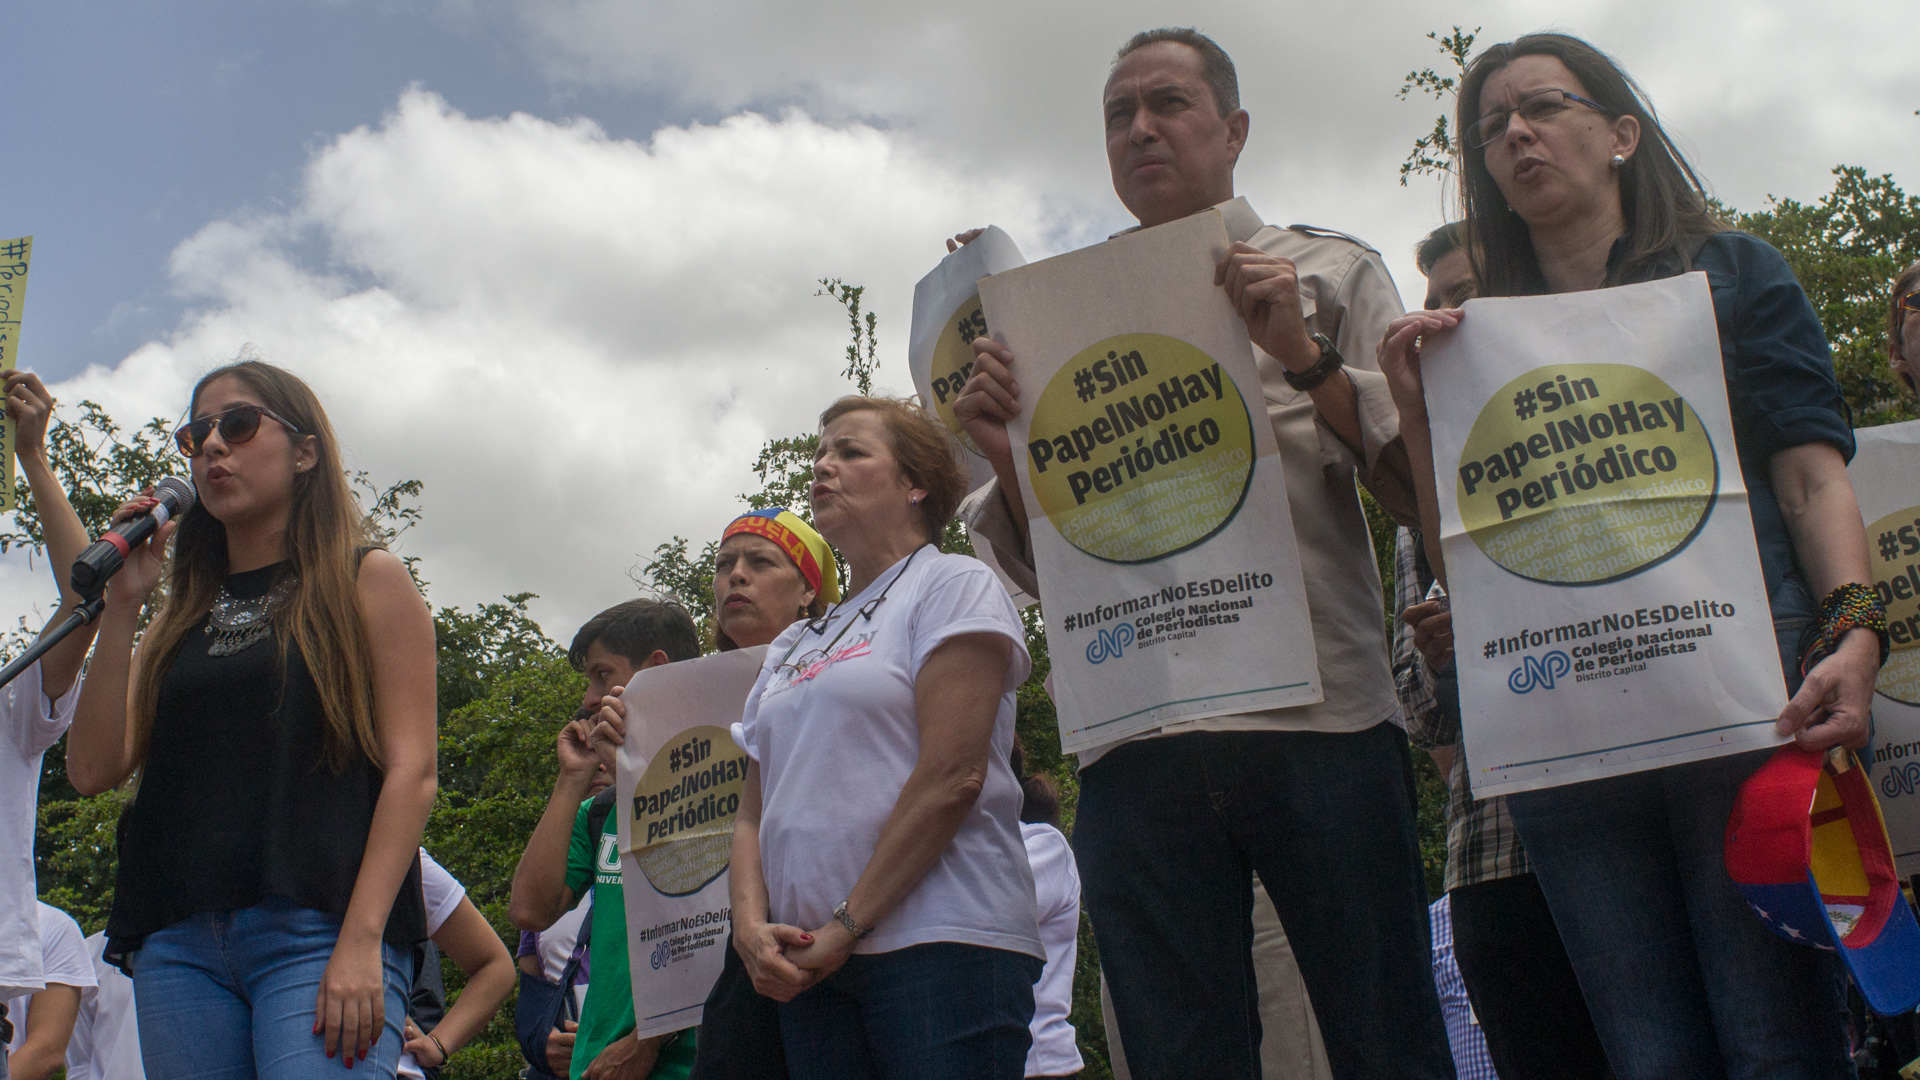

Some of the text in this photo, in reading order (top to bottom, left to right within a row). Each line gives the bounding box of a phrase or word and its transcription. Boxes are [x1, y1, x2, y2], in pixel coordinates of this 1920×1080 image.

[958, 308, 988, 345] #S
[1073, 350, 1149, 403] #Sin
[1513, 374, 1600, 421] #Sin
[1028, 362, 1224, 474] PapelNoHay
[1067, 417, 1220, 505] Periódico
[1459, 397, 1685, 496] PapelNoHay
[1495, 444, 1677, 521] Periódico
[1064, 571, 1273, 632] #InformarNoEsDelito
[1135, 596, 1253, 628] Colegio Nacional
[1137, 612, 1240, 640] de Periodistas
[1138, 630, 1196, 650] Distrito Capital
[1483, 600, 1735, 659] #InformarNoEsDelito
[1571, 624, 1712, 659] Colegio Nacional
[1574, 641, 1697, 673] de Periodistas
[1576, 662, 1647, 683] Distrito Capital
[669, 737, 711, 773] #Sin
[633, 755, 749, 820] PapelNoHay
[647, 793, 739, 845] Periódico
[640, 907, 732, 942] #InformarNoEsDelit
[670, 925, 724, 946] Colegio Nacional
[677, 937, 715, 954] Periodistas
